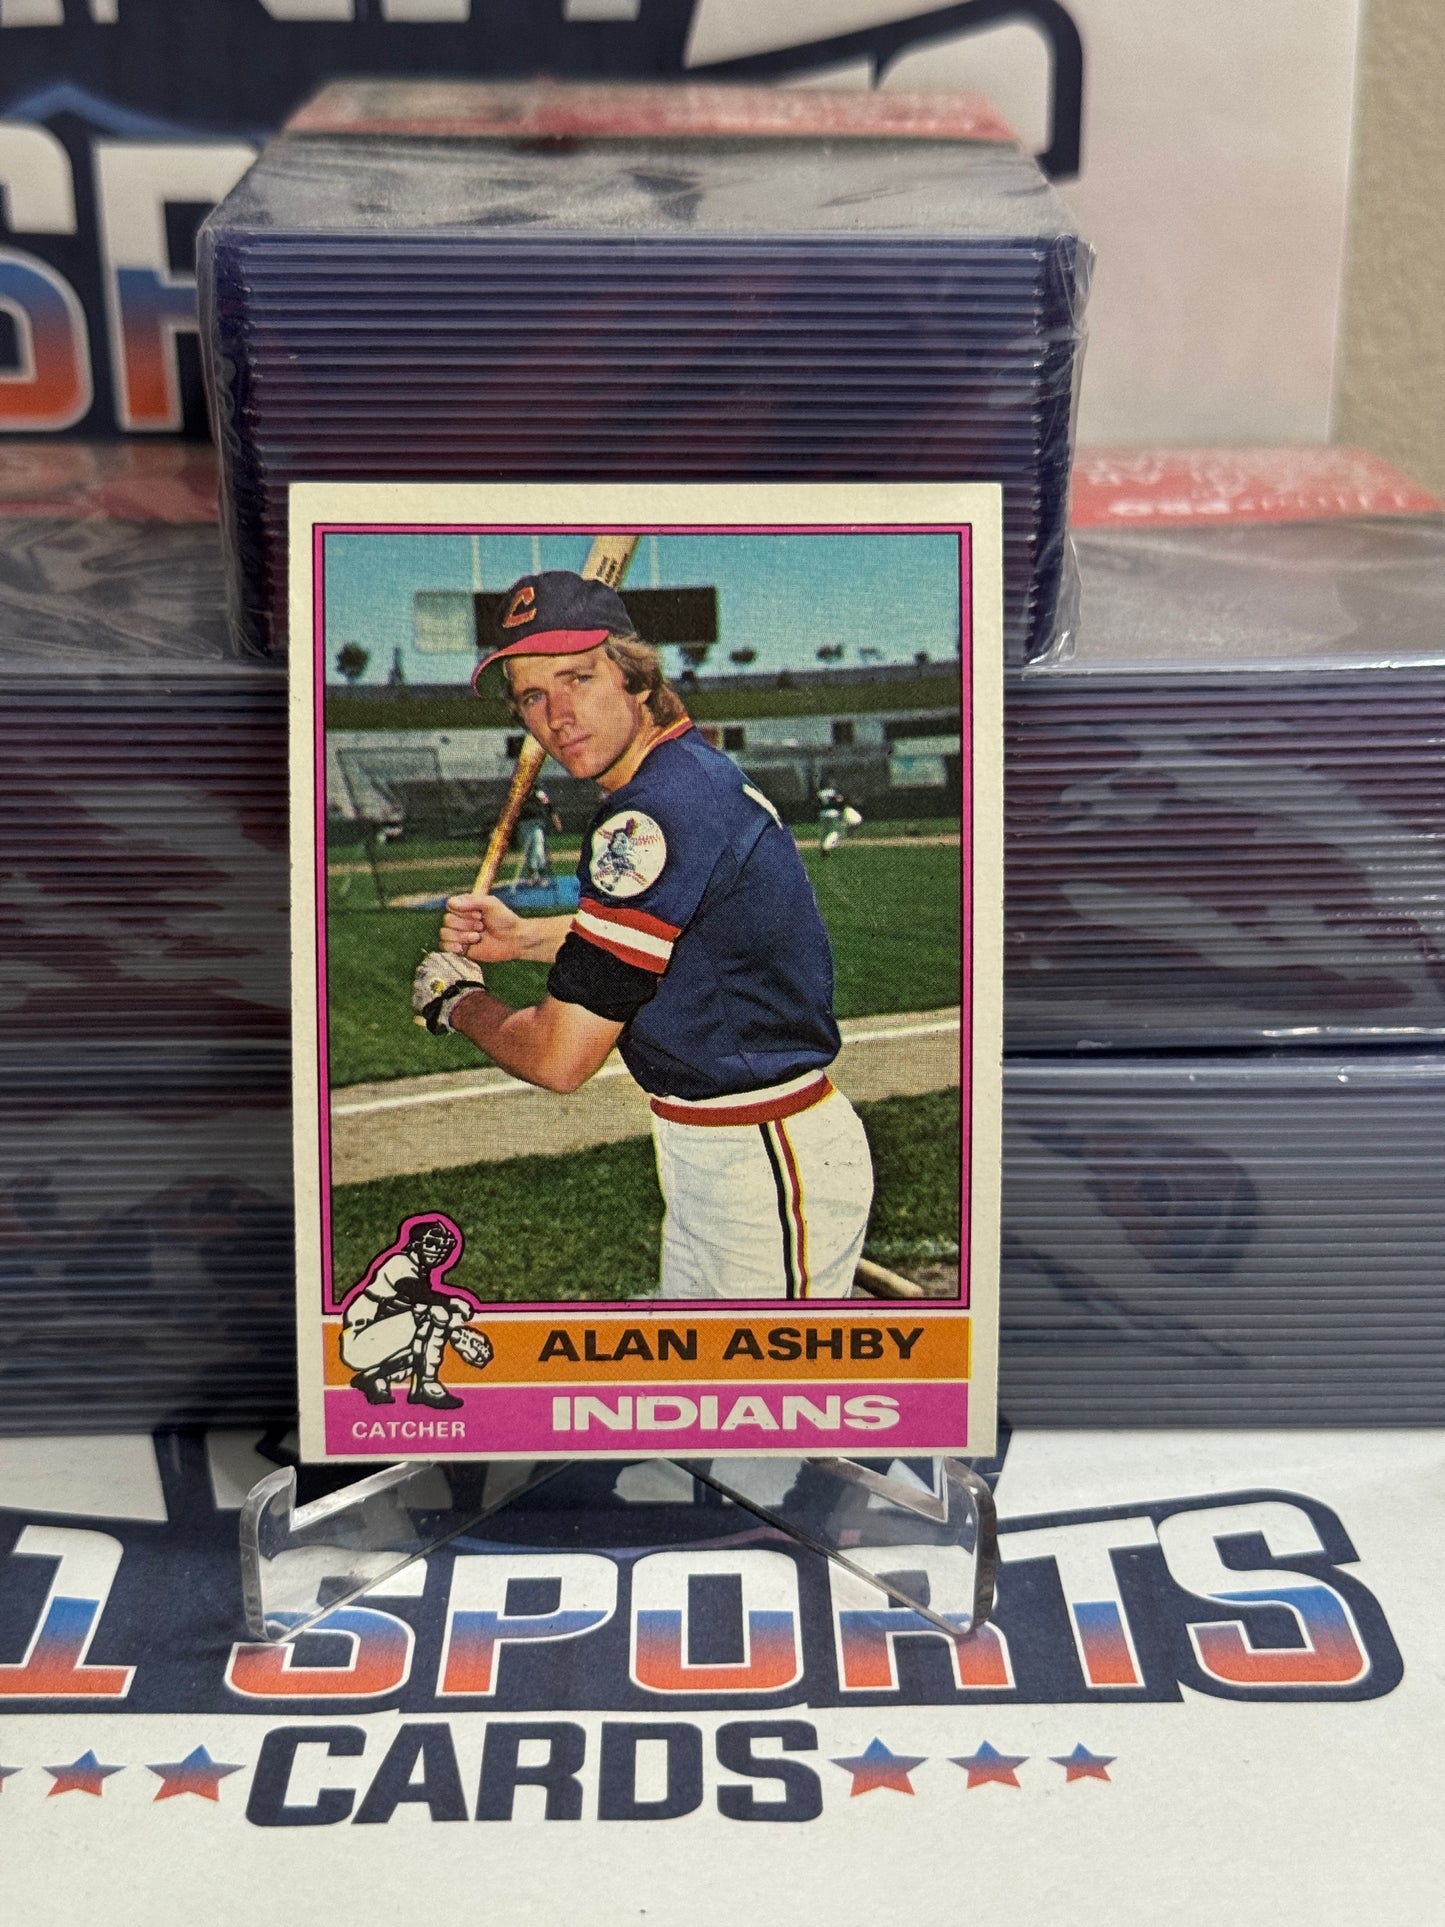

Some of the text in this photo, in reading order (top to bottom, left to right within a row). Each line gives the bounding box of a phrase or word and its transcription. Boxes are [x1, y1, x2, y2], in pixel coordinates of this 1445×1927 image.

[502, 586, 537, 628] C
[538, 1326, 924, 1362] ALAN ASHBY
[351, 1420, 466, 1440] CATCHER
[551, 1394, 900, 1432] INDIANS
[225, 1500, 1371, 1699] SPORTS
[245, 1719, 823, 1827] CARDS
